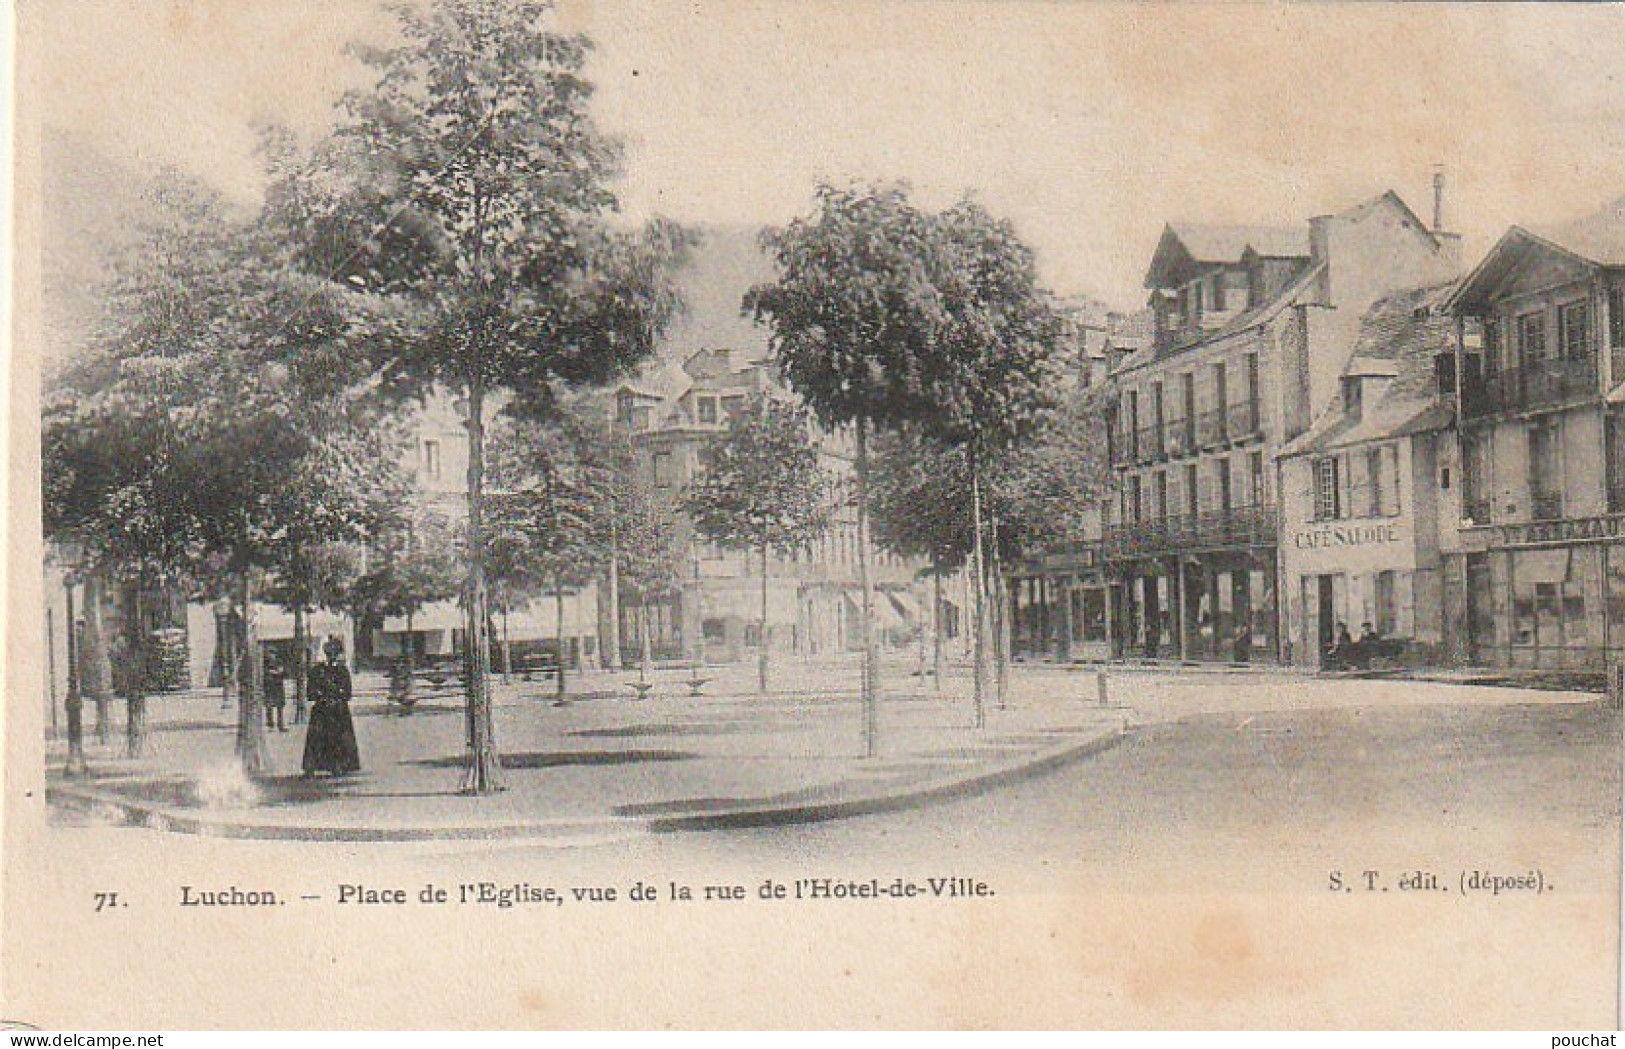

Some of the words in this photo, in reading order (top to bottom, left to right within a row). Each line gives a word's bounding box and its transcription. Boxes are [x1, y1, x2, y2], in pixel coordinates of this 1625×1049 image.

[94, 893, 129, 913] 71.
[181, 886, 286, 907] Luchon.
[337, 883, 407, 905] Place
[419, 883, 447, 903] de
[460, 882, 563, 908] l'Eglise,
[571, 887, 616, 901] vue
[628, 881, 657, 901] de
[669, 881, 692, 901] la
[704, 886, 745, 900] rue
[759, 880, 786, 900] de
[1329, 871, 1352, 893] S.
[1362, 870, 1389, 892] T.
[1398, 870, 1448, 892] édit.
[1460, 869, 1554, 896] (déposé).
